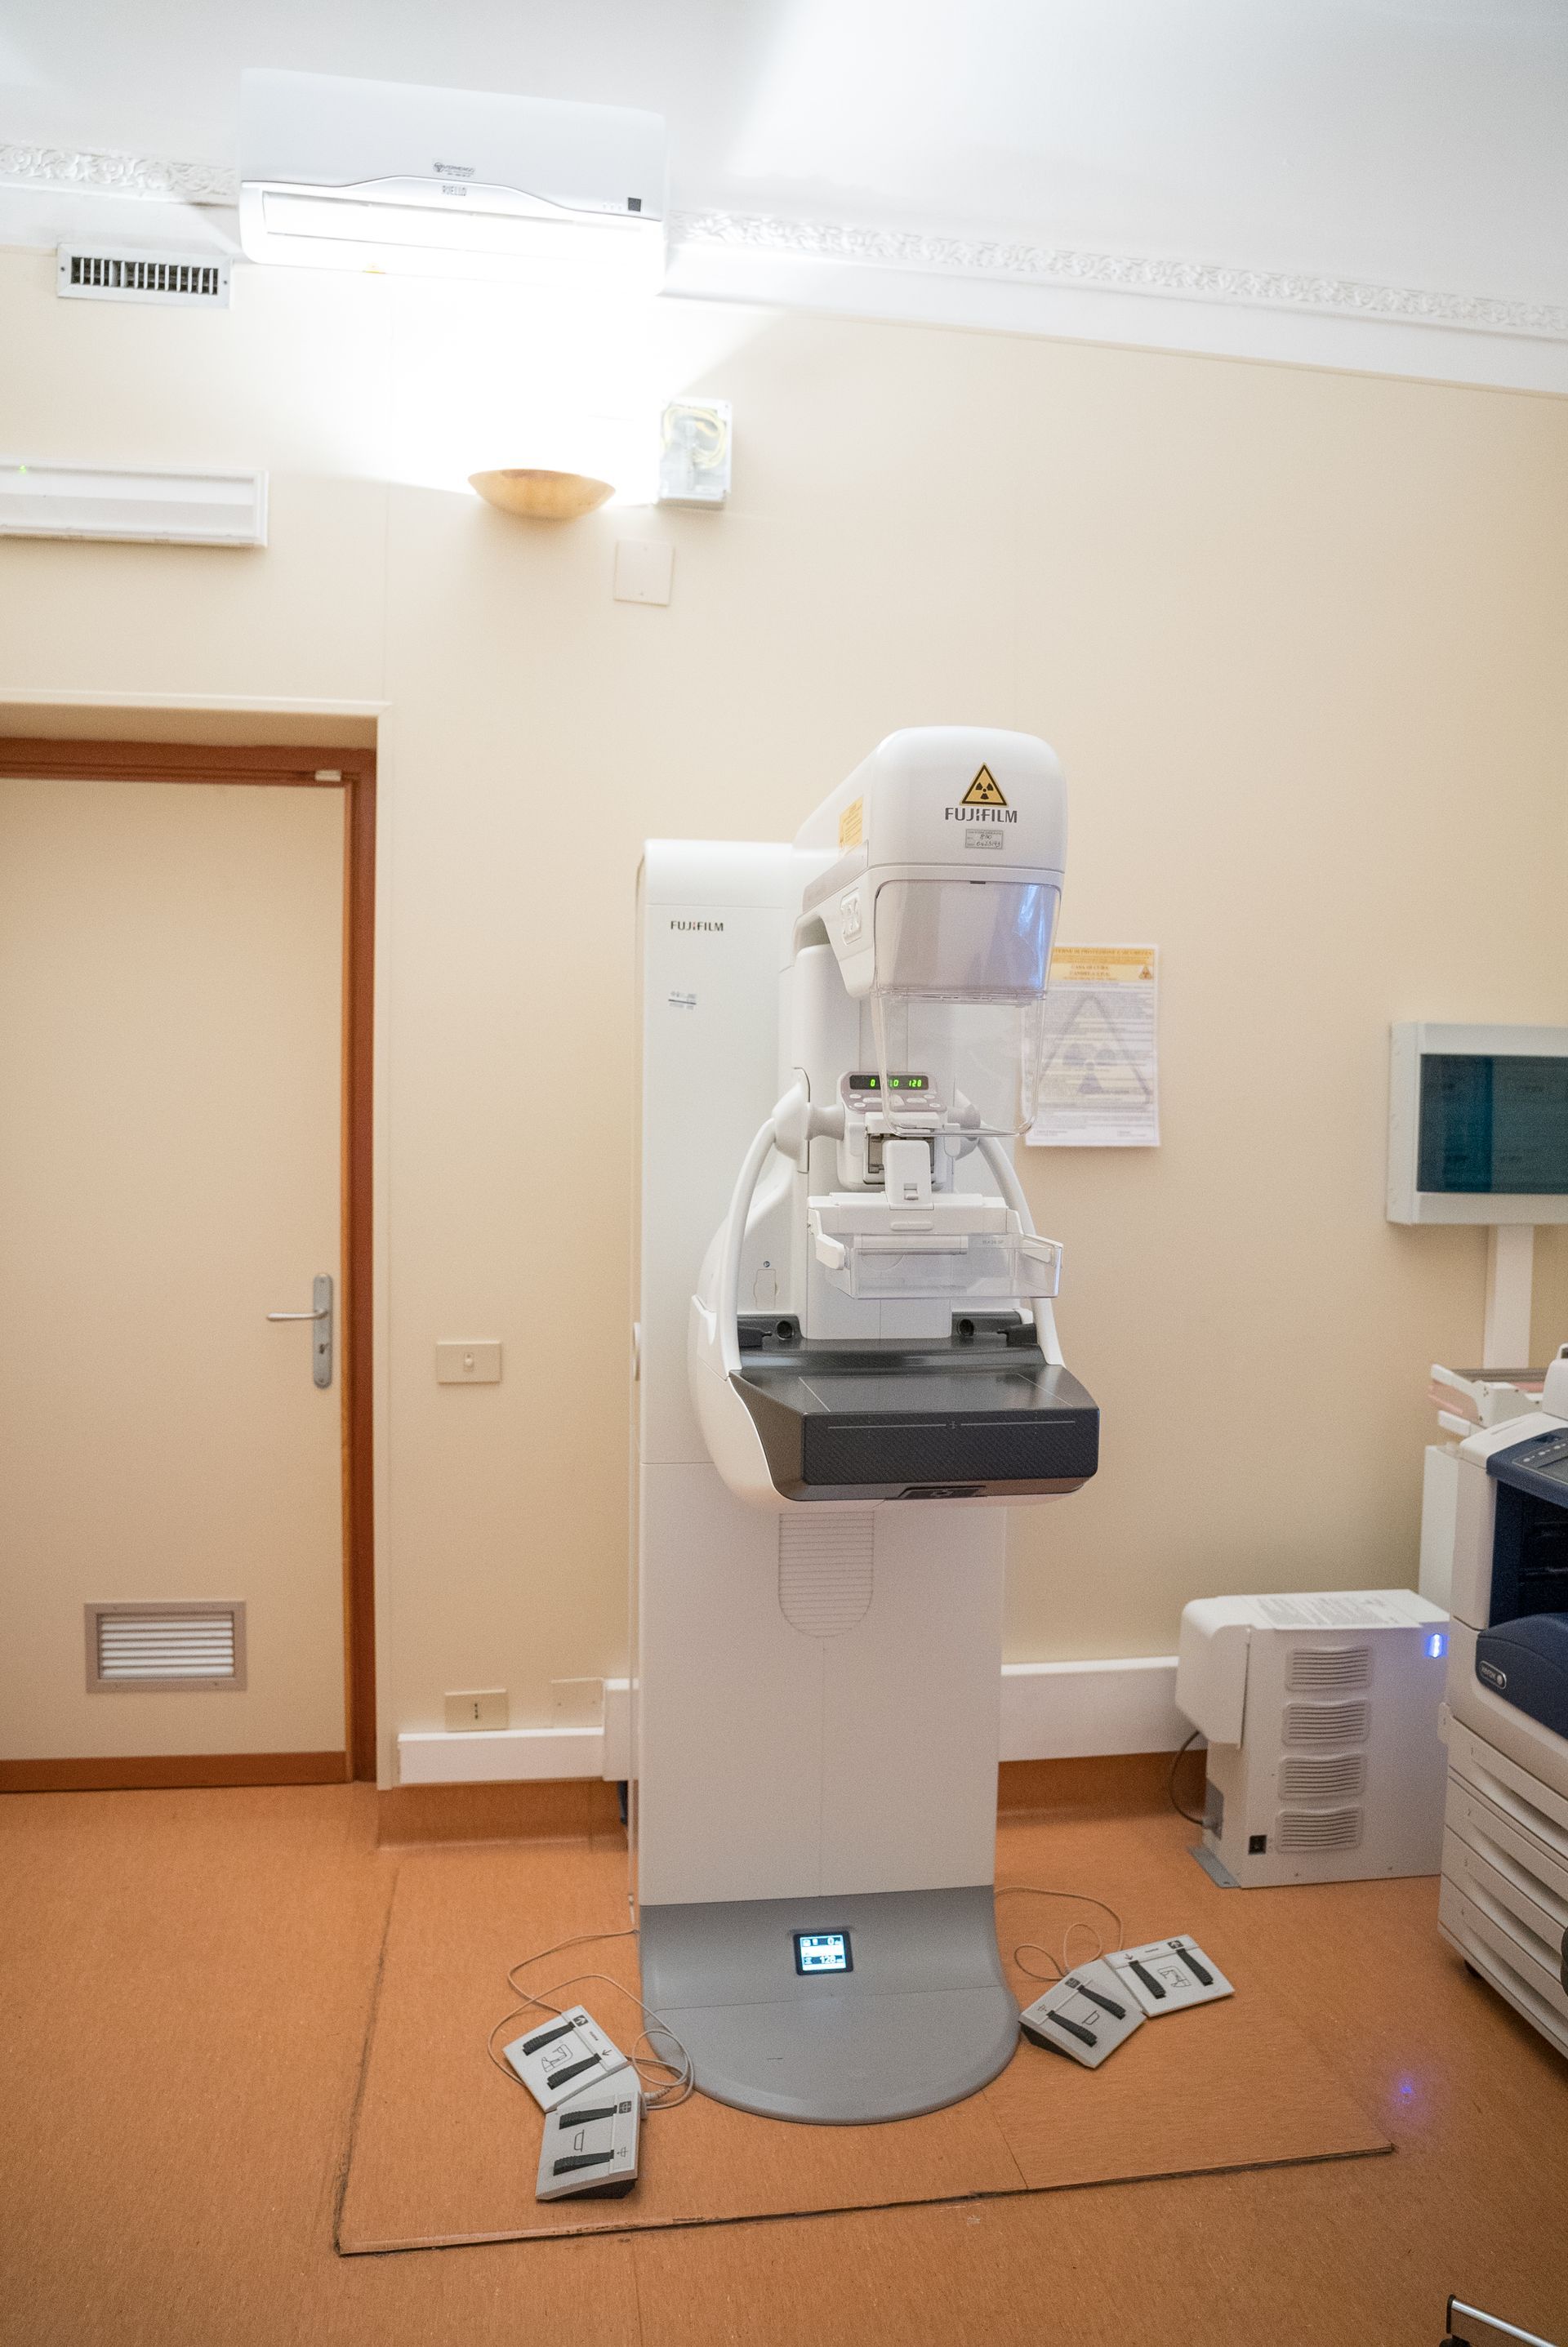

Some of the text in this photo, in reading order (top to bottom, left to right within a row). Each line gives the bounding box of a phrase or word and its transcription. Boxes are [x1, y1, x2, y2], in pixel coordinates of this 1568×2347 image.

[945, 807, 1018, 823] FUJIFILM
[670, 920, 724, 932] FUJIFILM
[870, 1079, 875, 1087] 0
[909, 1079, 922, 1087] 128
[820, 1955, 836, 1965] 128
